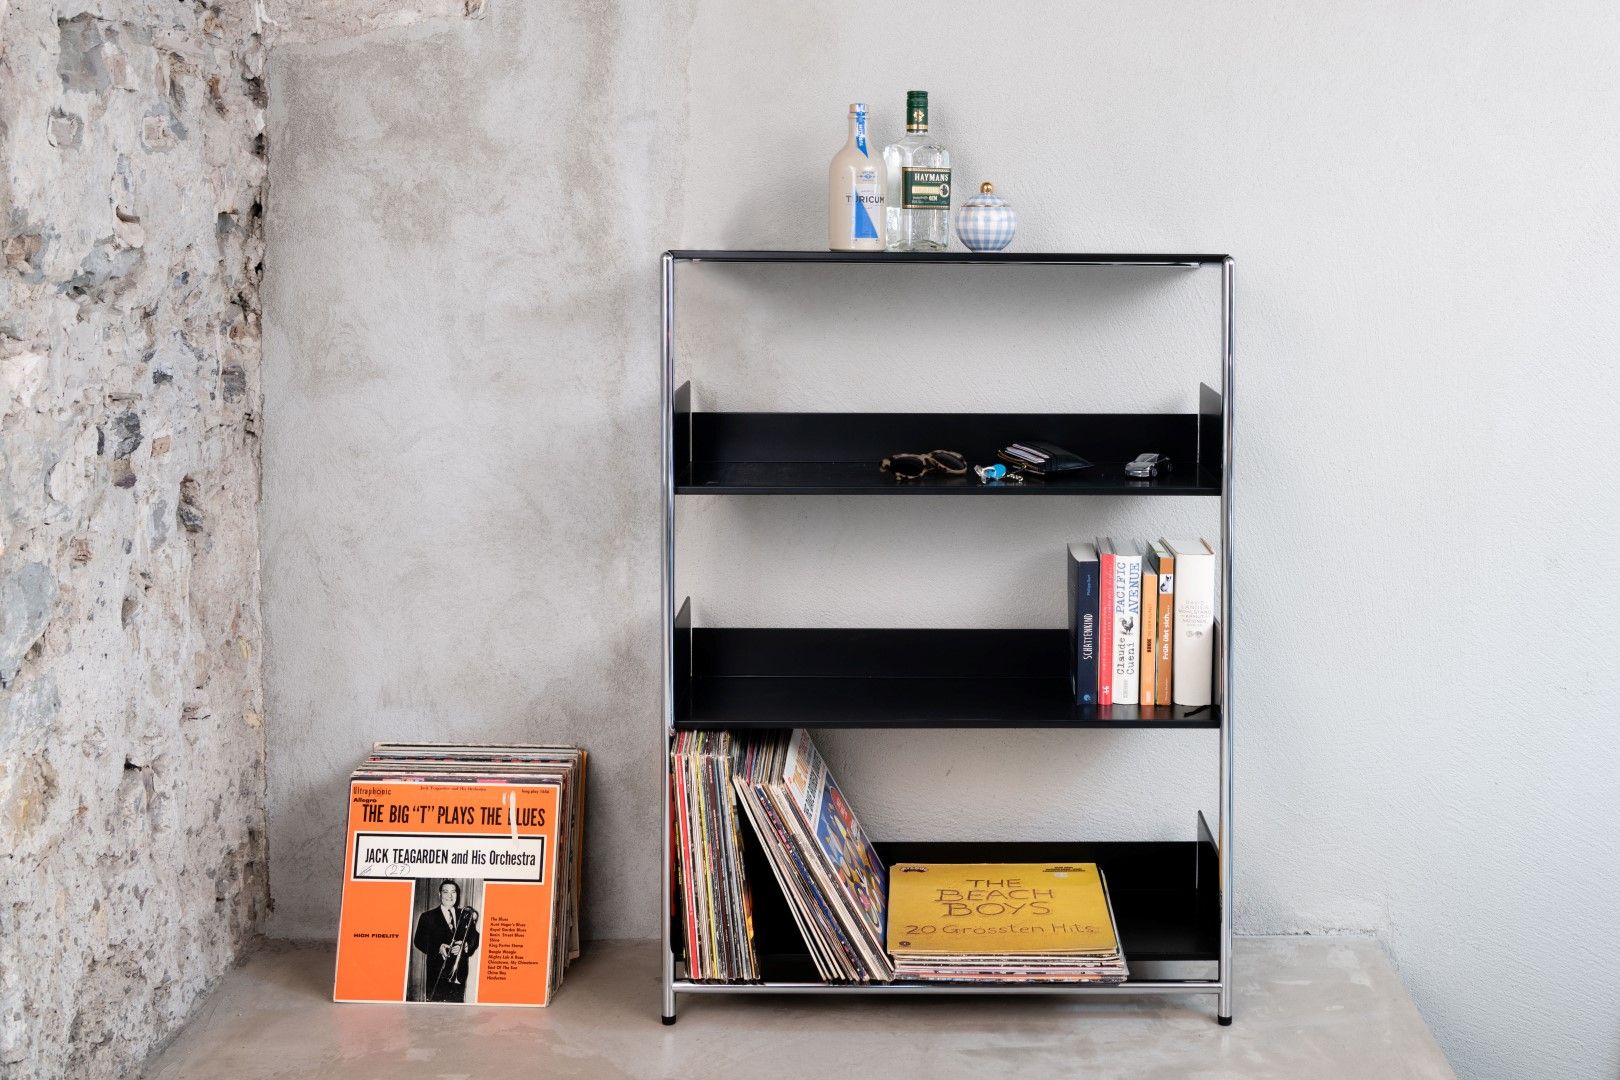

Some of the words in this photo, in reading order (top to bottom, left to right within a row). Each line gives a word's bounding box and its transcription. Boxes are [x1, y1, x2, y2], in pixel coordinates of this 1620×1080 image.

[1116, 562, 1126, 614] PACIFIC
[1128, 563, 1140, 614] AVENUE
[1083, 613, 1093, 660] SCHATTENKIND
[1116, 637, 1126, 675] Claude
[1126, 642, 1135, 675] Cueni
[362, 804, 384, 822] THE
[389, 805, 410, 823] BIG
[437, 806, 475, 825] PLAYS
[480, 807, 503, 825] THE
[365, 848, 389, 863] JACK
[393, 848, 449, 864] TEAGARDEN
[451, 849, 469, 865] and
[471, 849, 486, 865] His
[489, 850, 536, 866] Orchestra
[966, 879, 1022, 888] THE
[935, 888, 1054, 902] BEACH
[941, 901, 1052, 917] BOYS
[905, 924, 937, 934] 20
